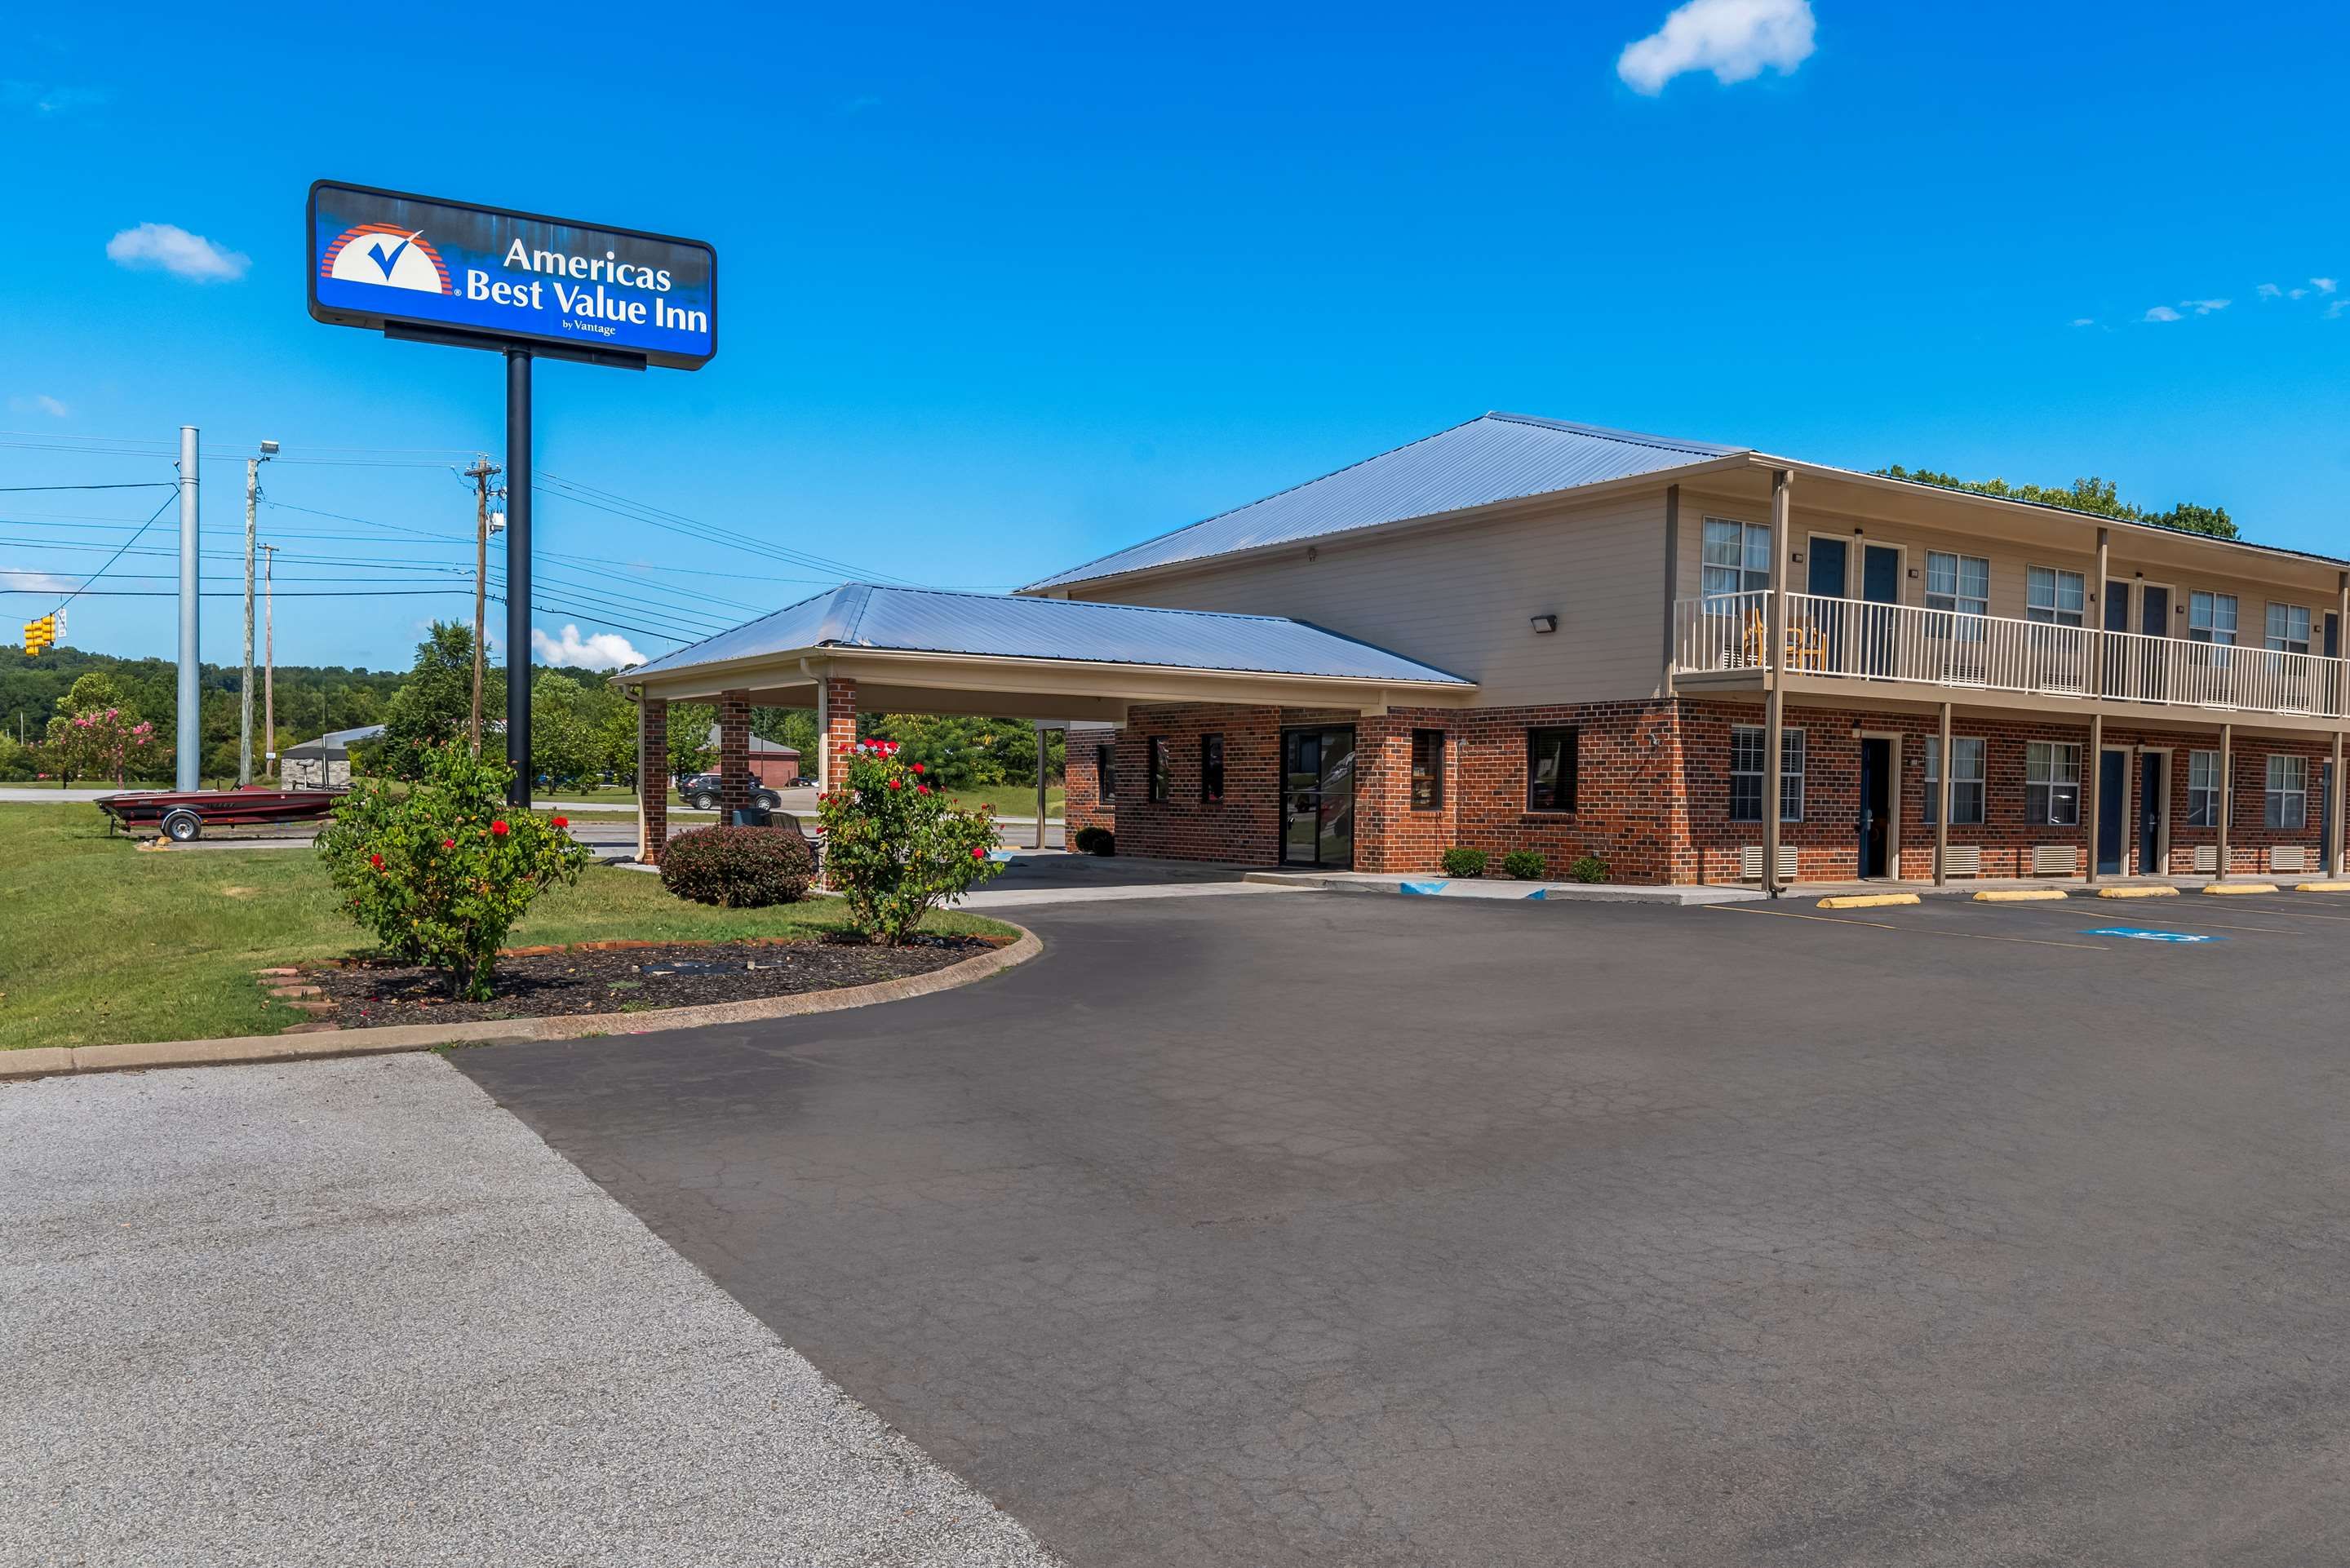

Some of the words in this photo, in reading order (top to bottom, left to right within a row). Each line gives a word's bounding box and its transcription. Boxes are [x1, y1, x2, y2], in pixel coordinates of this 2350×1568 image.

[503, 237, 672, 292] Americas
[467, 269, 543, 310] Best
[553, 282, 647, 325] Value
[656, 297, 707, 334] Inn
[562, 320, 573, 330] by
[574, 320, 616, 337] Vantage
